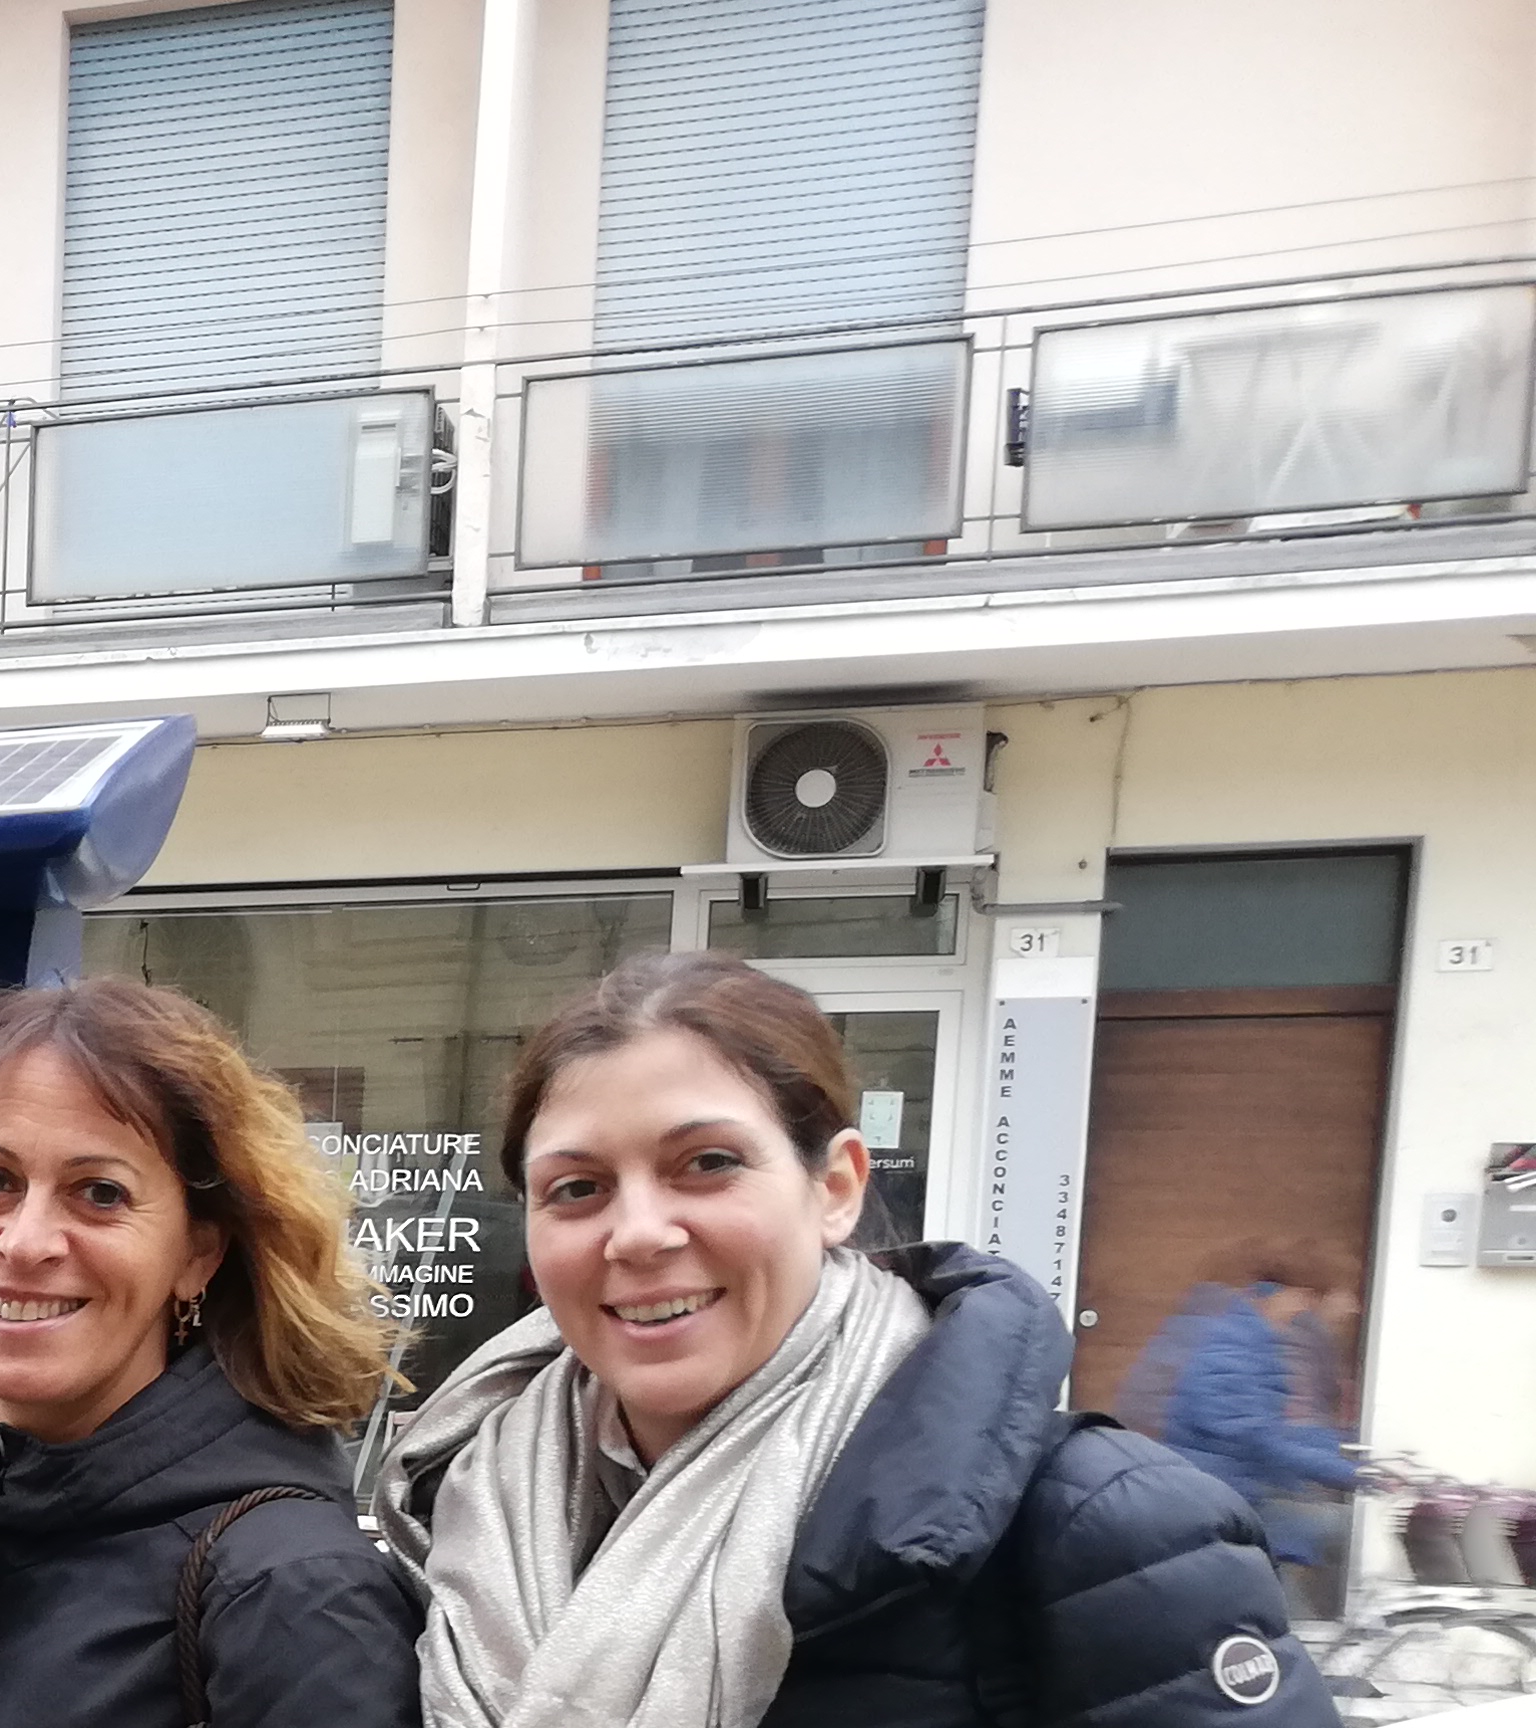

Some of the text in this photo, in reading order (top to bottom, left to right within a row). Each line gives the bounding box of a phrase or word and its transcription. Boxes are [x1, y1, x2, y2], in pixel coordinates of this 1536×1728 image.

[1020, 933, 1045, 952] 31
[1449, 945, 1478, 965] 31
[999, 1018, 1017, 1098] AEMME
[349, 1168, 484, 1192] ADRIANA
